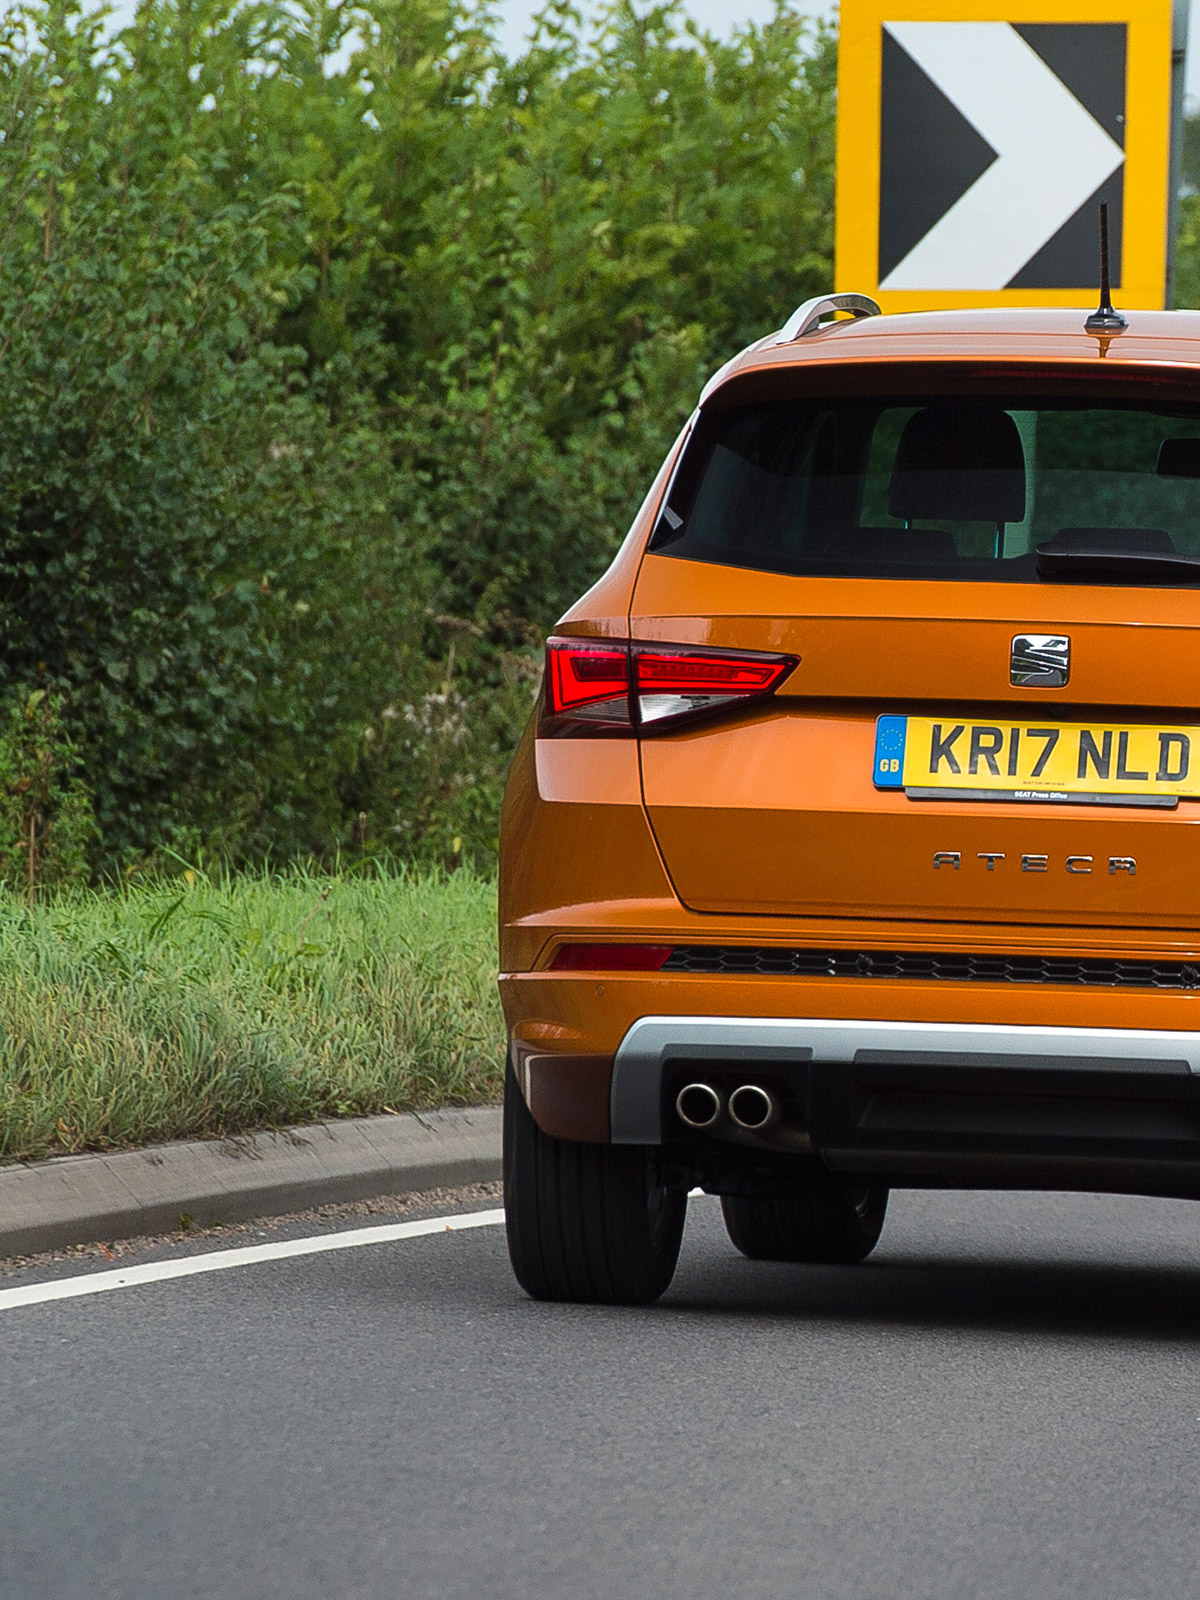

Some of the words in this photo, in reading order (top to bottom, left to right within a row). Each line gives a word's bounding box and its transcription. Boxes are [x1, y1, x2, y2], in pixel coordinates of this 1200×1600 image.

[928, 723, 1060, 777] KR17
[1076, 729, 1191, 782] NLD
[879, 758, 900, 773] GB
[1014, 790, 1031, 798] SEAT
[1031, 791, 1049, 799] Press
[1049, 791, 1068, 800] Office
[932, 851, 1137, 875] ATECA
